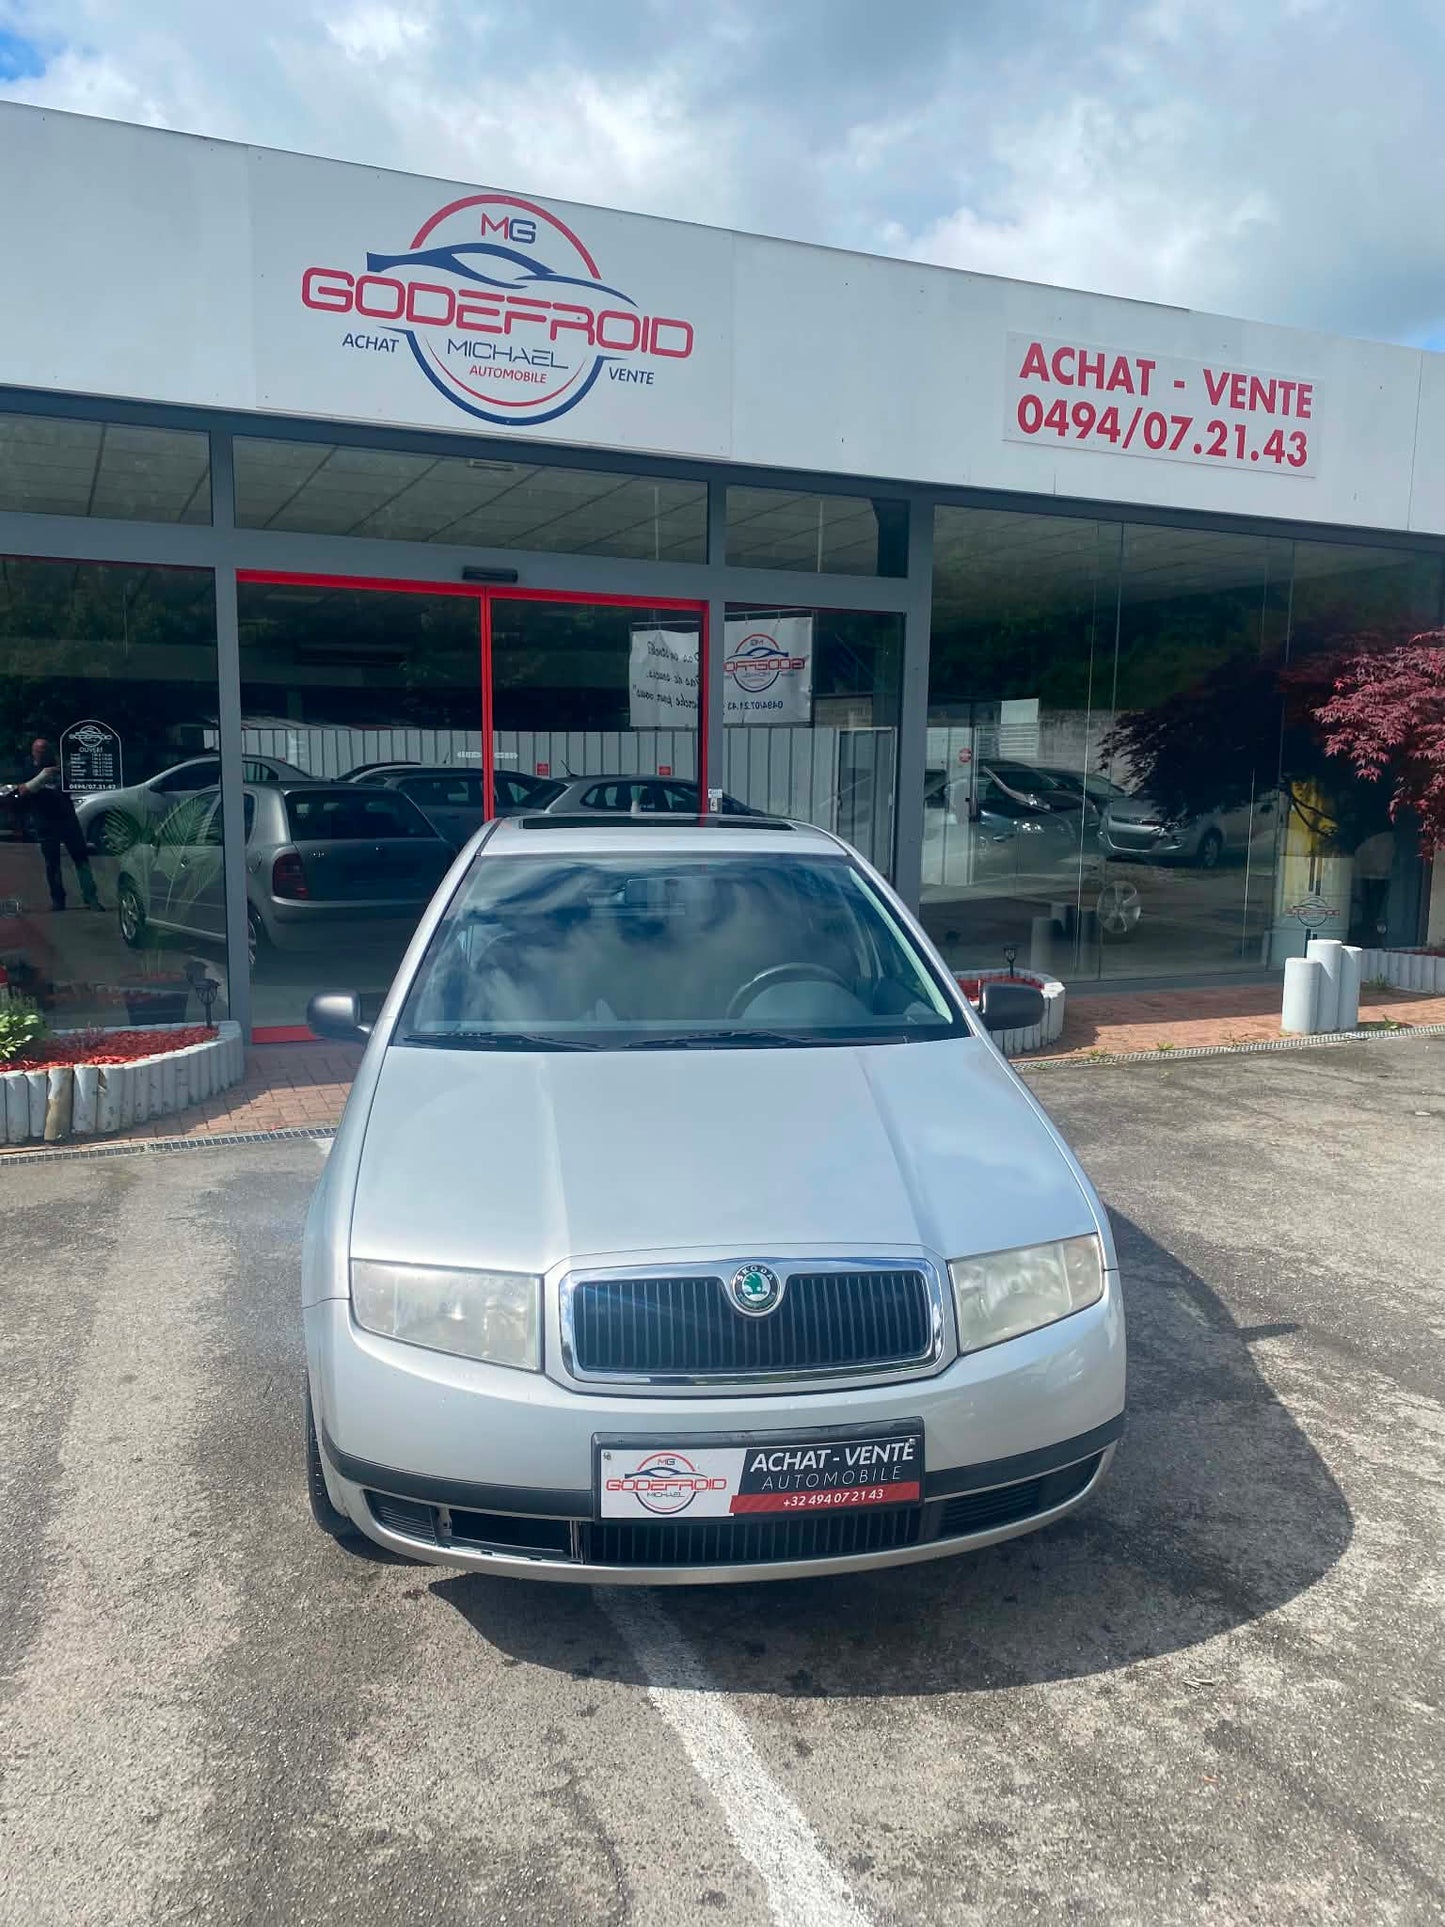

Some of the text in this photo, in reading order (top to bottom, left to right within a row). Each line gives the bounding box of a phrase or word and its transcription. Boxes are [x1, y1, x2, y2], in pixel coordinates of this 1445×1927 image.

[481, 212, 537, 244] MG
[301, 267, 694, 359] GODEFROID
[342, 332, 400, 353] ACHAT
[447, 338, 569, 370] MICHAEL
[469, 364, 547, 384] AUTOMOBILE
[608, 367, 655, 385] VENTE
[1018, 342, 1313, 419] ACHAT - VENTE
[1017, 393, 1308, 467] 0494/07.21.43
[657, 1458, 676, 1466] MG
[750, 1449, 832, 1473] ACHAT
[845, 1442, 916, 1467] VENTE
[605, 1477, 727, 1492] GODEFROID
[761, 1465, 902, 1491] AUTOMOBILE
[646, 1490, 686, 1498] MICHAEL
[783, 1488, 884, 1508] +32 494 07 21 43
